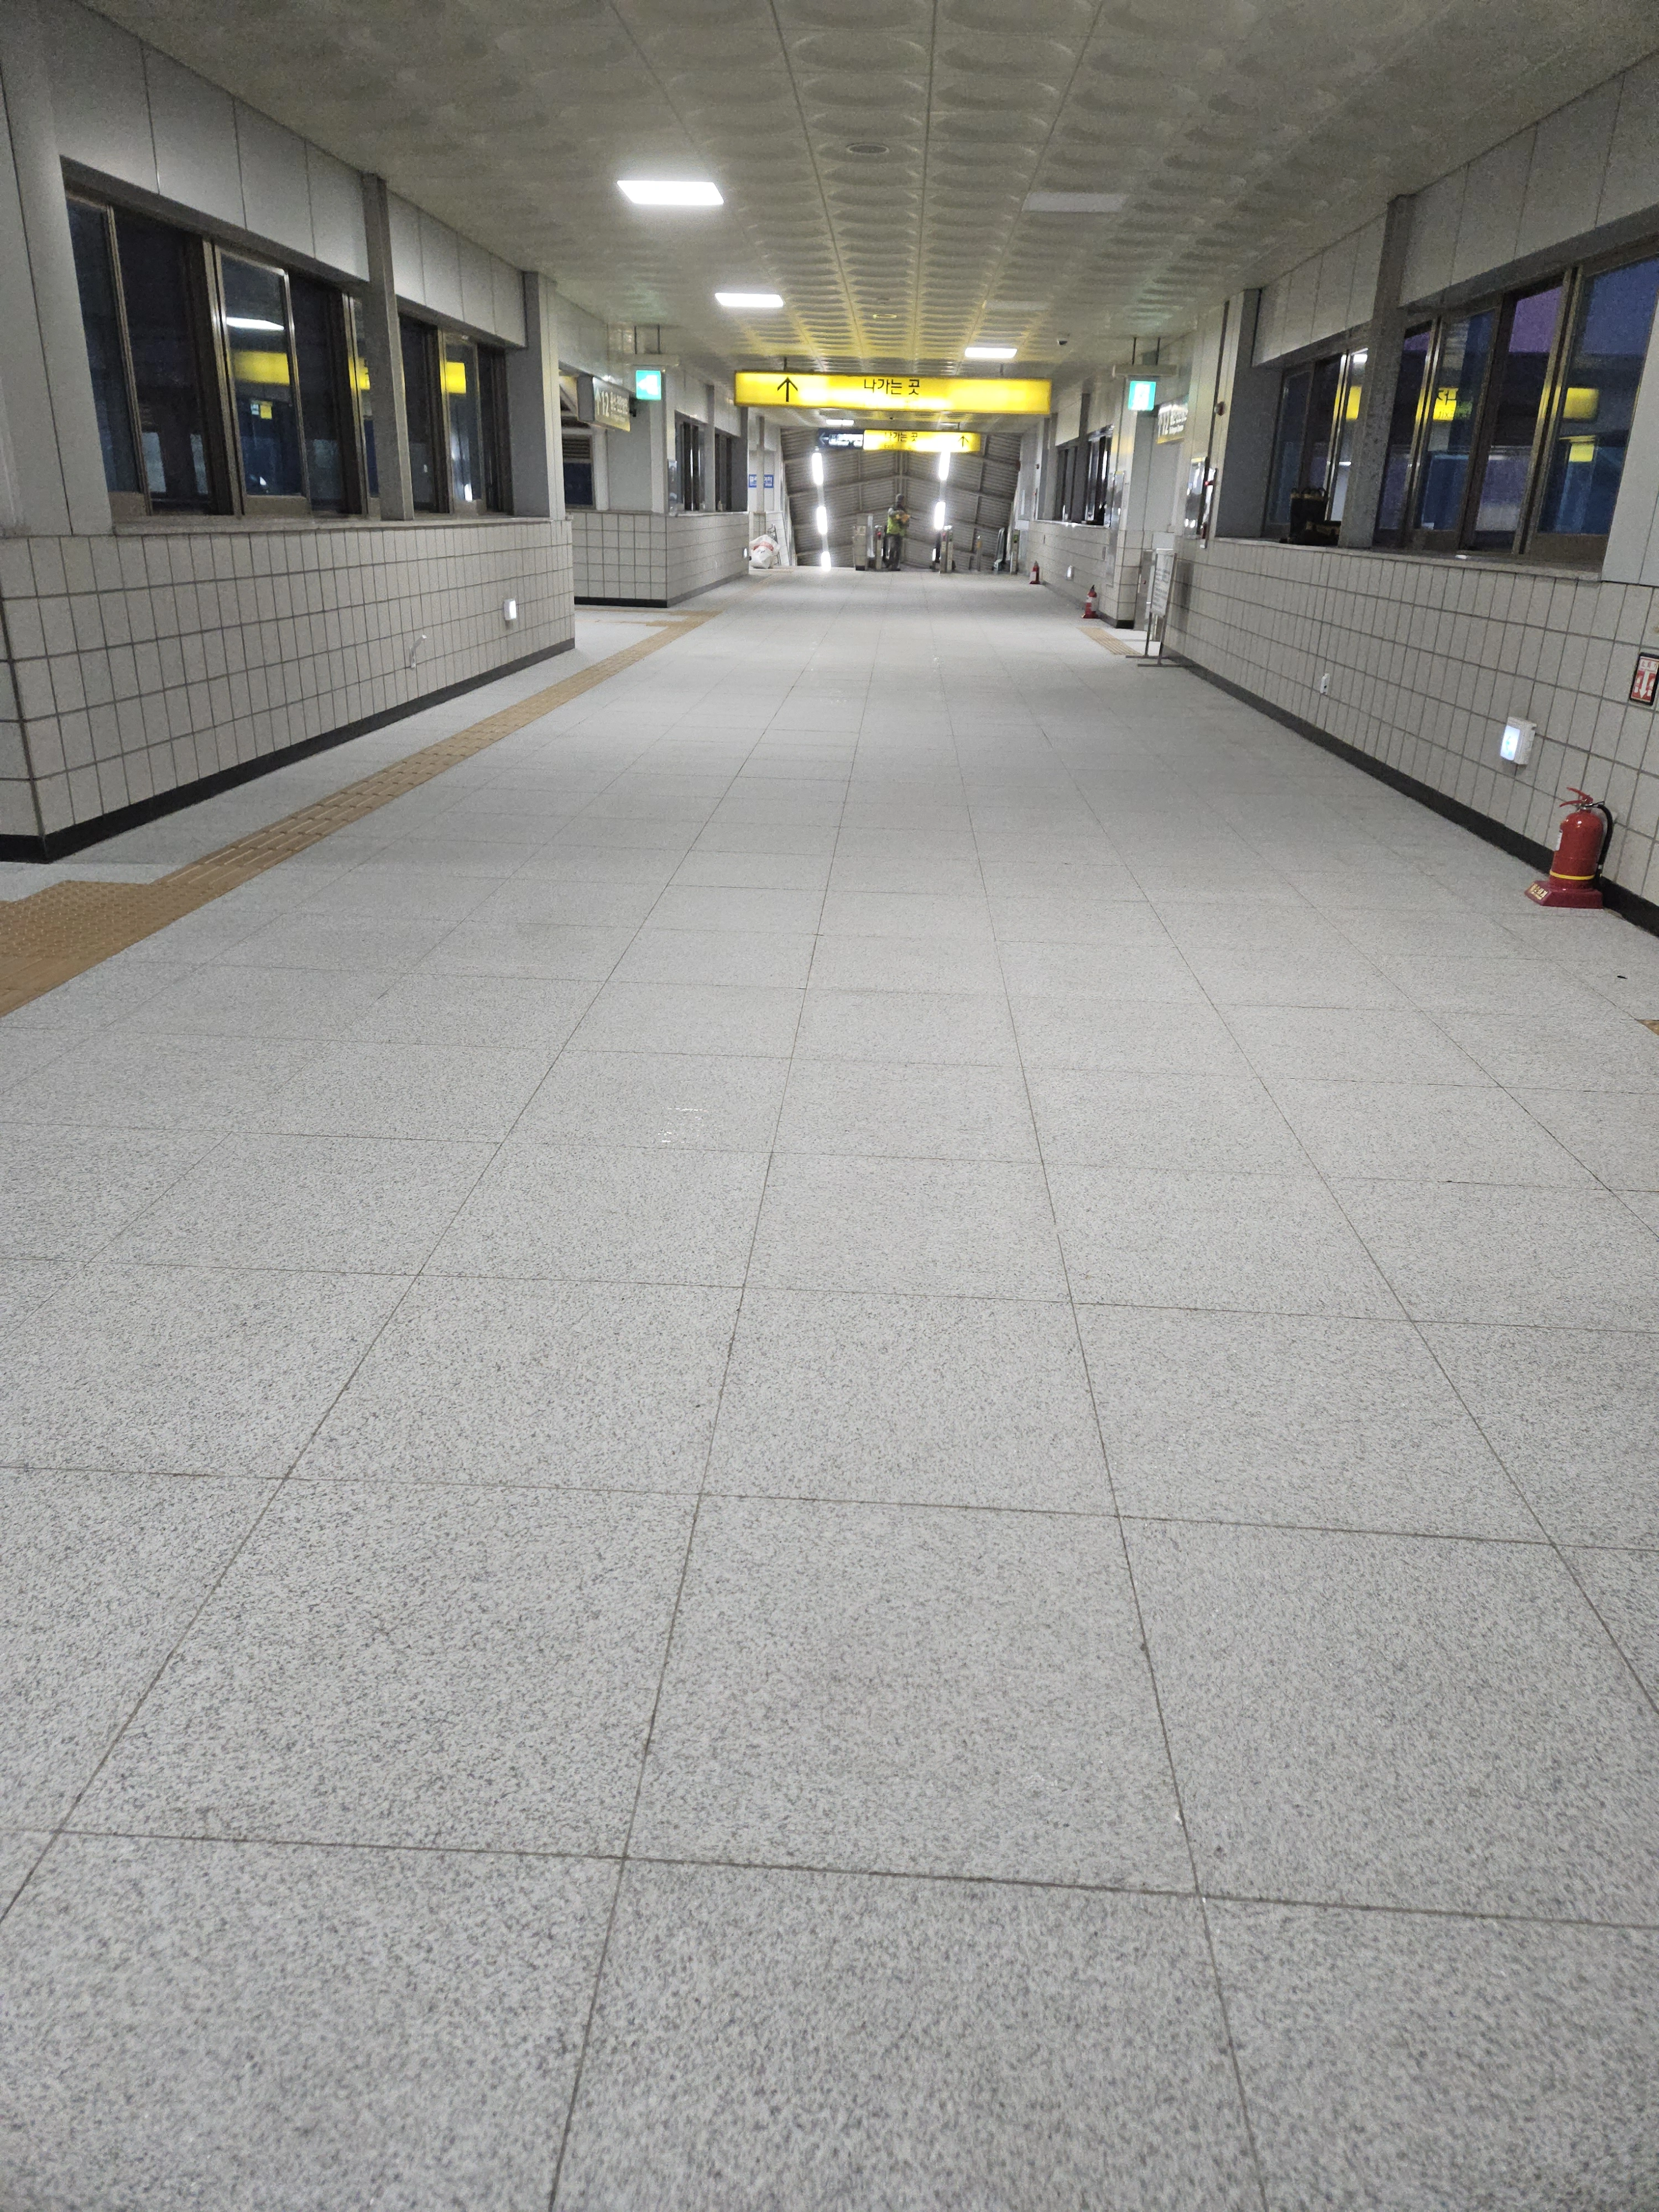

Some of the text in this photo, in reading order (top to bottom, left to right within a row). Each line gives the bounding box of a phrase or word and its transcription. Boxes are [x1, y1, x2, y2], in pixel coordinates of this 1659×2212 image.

[864, 378, 920, 395] 나가는 곳
[884, 432, 918, 442] 나가는 곳
